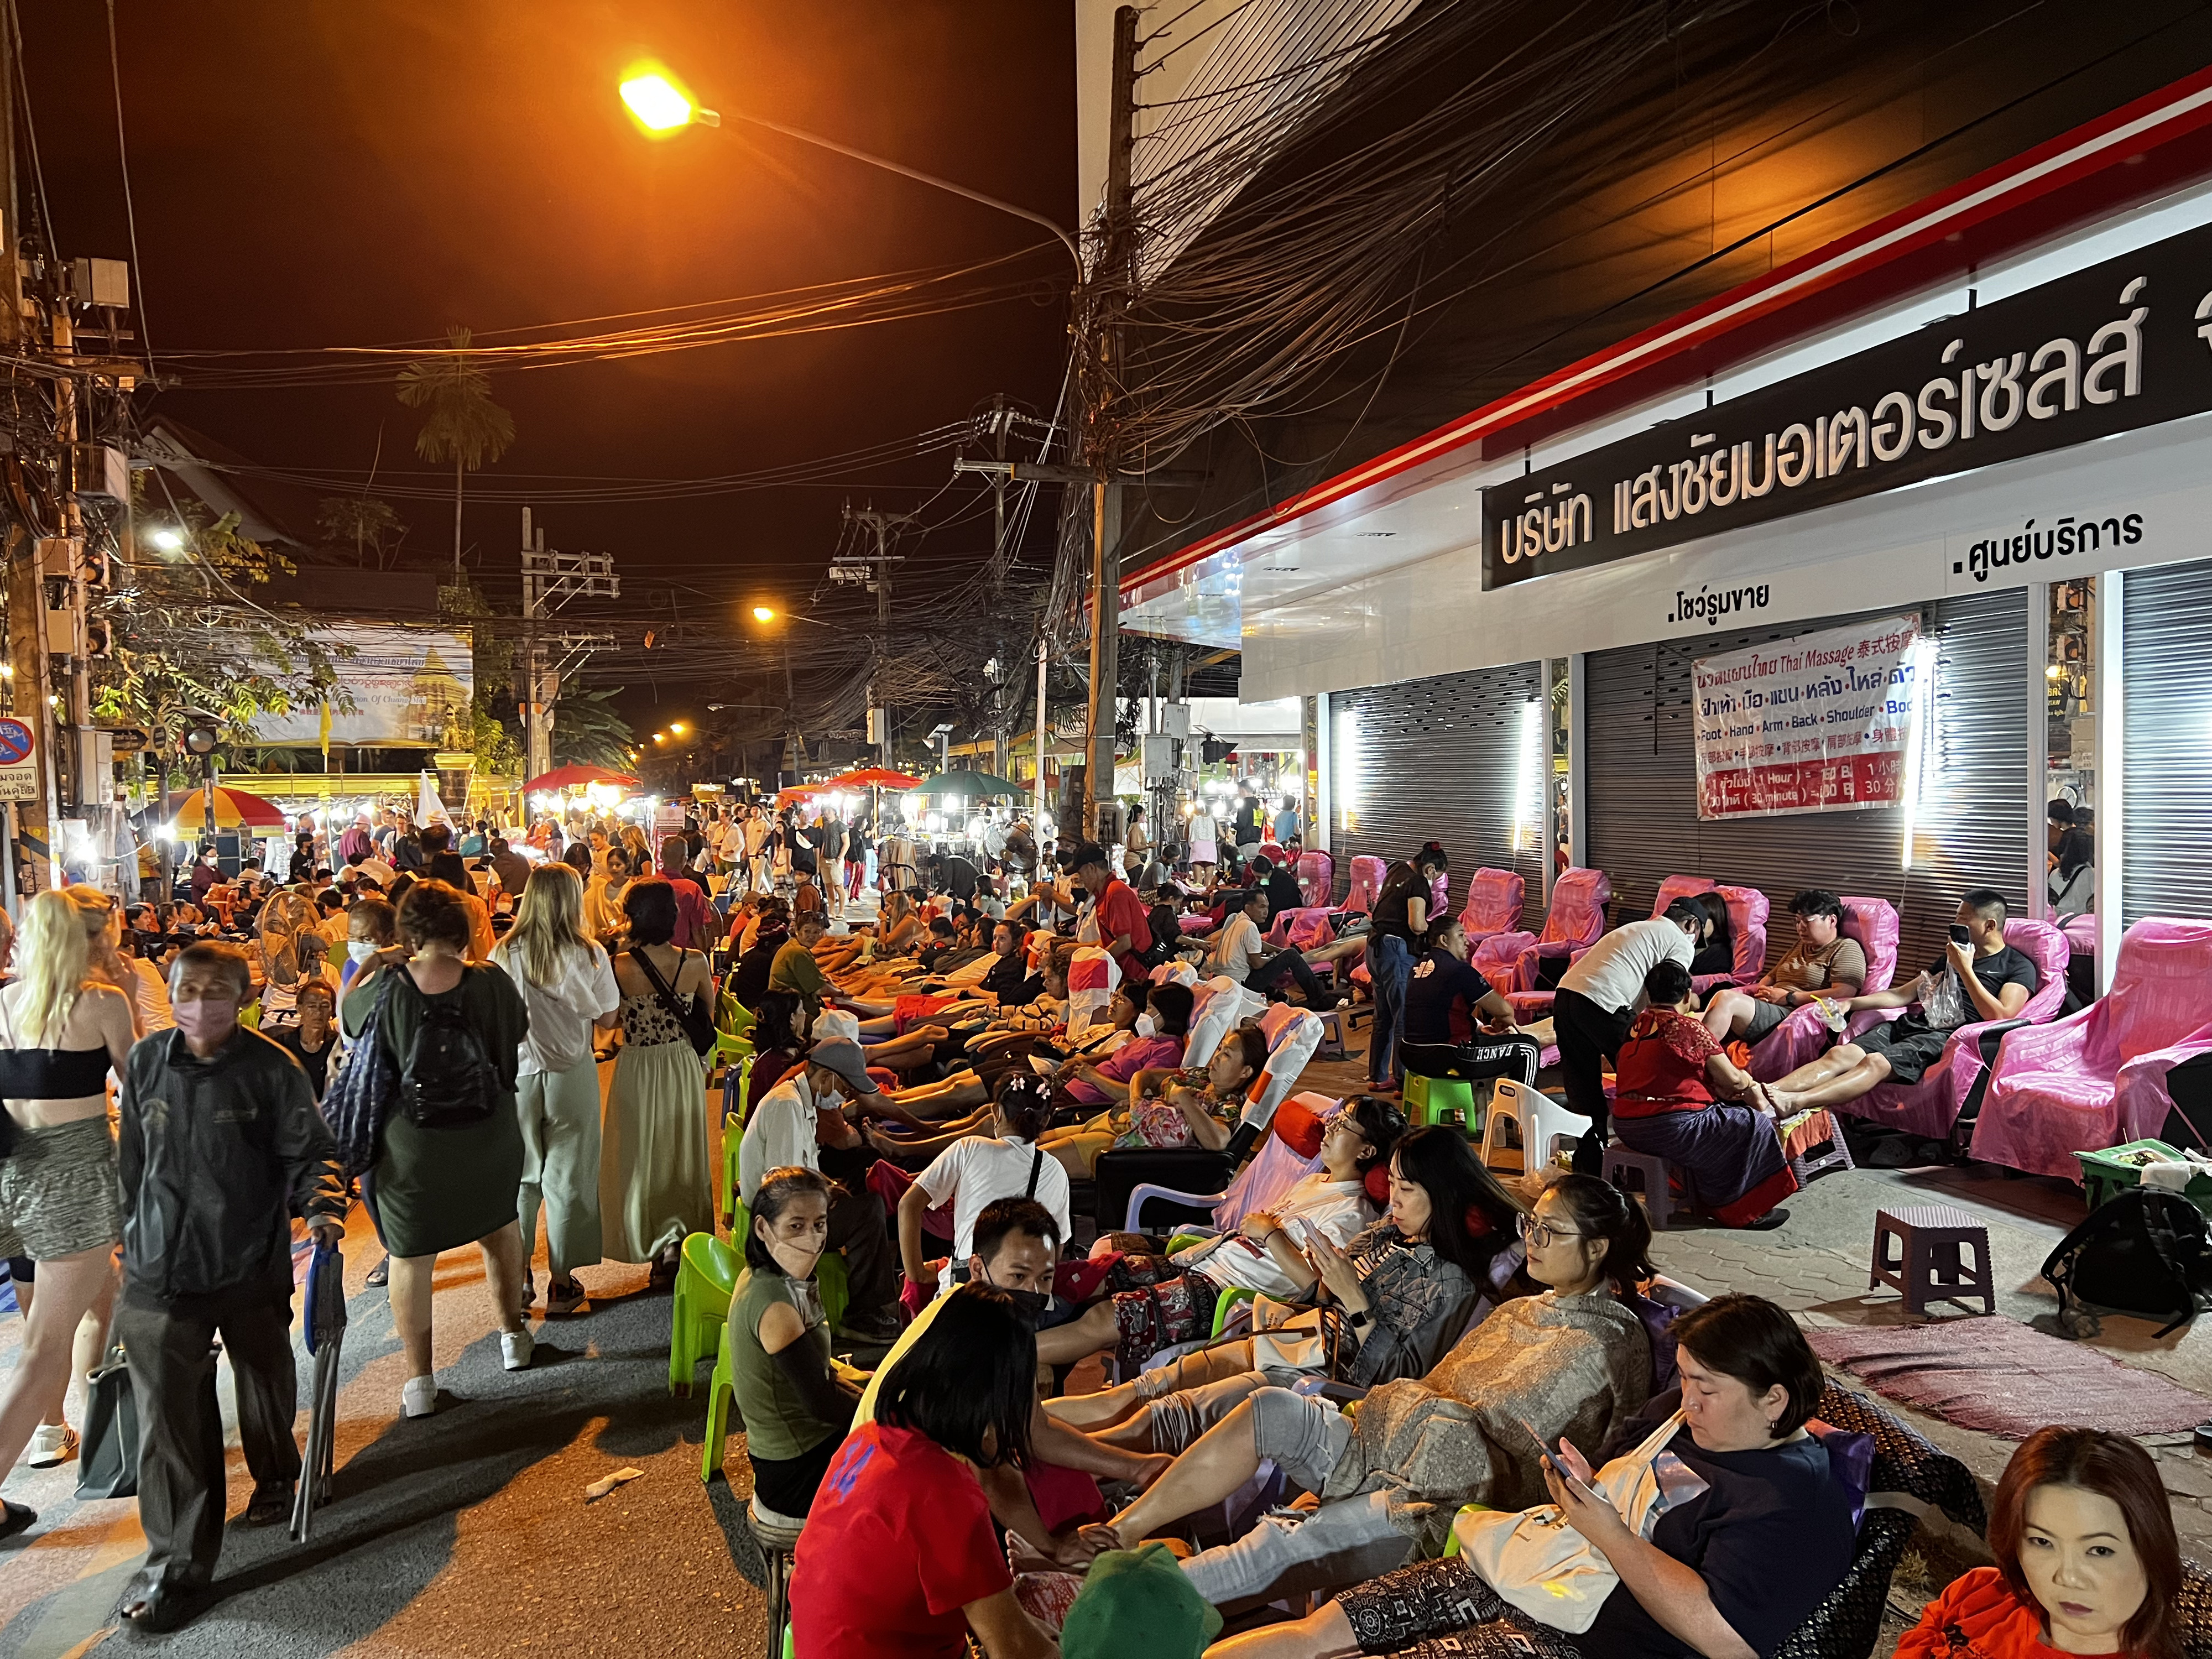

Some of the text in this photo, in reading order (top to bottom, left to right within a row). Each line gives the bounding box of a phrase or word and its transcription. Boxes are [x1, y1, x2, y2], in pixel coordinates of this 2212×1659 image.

[1501, 481, 1592, 565] บริษัท
[1781, 652, 1803, 673] Thai
[1806, 645, 1854, 669] Massage
[1806, 675, 1842, 699] หลัง
[1845, 666, 1882, 692] ไหล่
[1730, 724, 1754, 737] Hand
[1762, 720, 1783, 733] Arm
[1792, 713, 1818, 728] Back
[1827, 706, 1875, 724] Shoulder
[1767, 773, 1793, 784] Hour
[1865, 780, 1880, 794] 30
